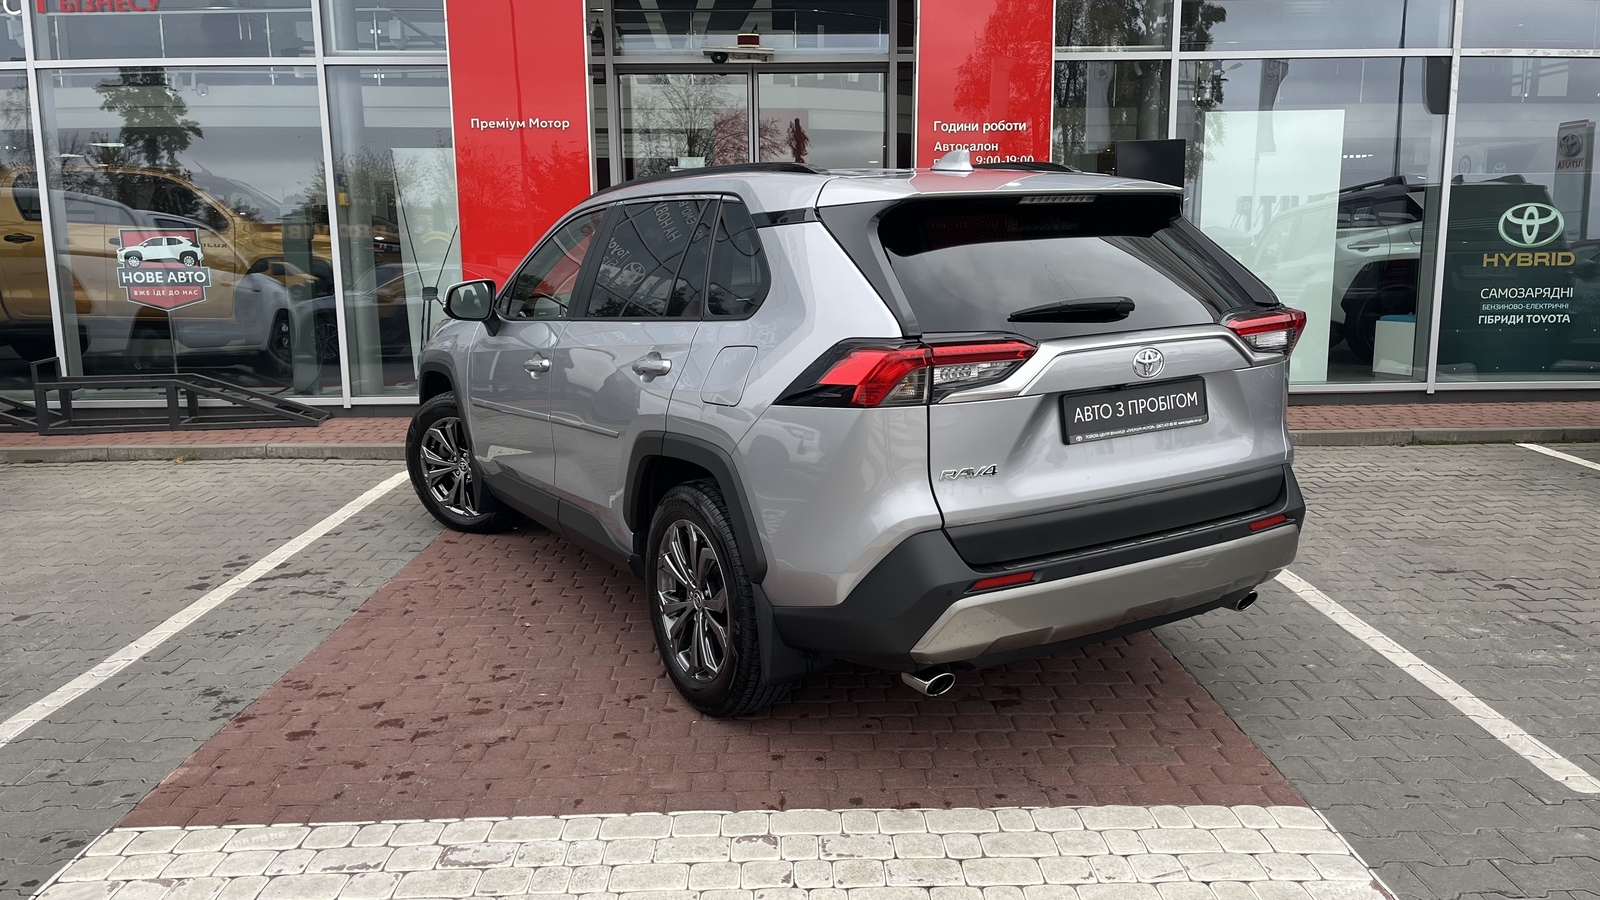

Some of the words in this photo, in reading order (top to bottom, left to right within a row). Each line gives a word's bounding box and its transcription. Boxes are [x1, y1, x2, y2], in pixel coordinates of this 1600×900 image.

[470, 117, 526, 131] Преміум
[528, 117, 570, 131] Мотор
[933, 120, 979, 134] Години
[982, 120, 1027, 134] роботи
[933, 141, 999, 152] Автосалон
[1482, 252, 1576, 268] HYBRID
[122, 271, 164, 284] НОВЕ
[167, 270, 207, 283] АВТО
[153, 289, 166, 297] ЇДЕ
[1480, 287, 1574, 300] САМОЗАРЯДНІ
[1482, 303, 1570, 311] БЕНЗИНОВО-ЕЛЕКТРИЧНІ
[1478, 315, 1524, 325] ГІБРИДИ
[1526, 314, 1571, 324] TOYOTA
[1074, 403, 1113, 423] АВТО
[1116, 401, 1125, 417] З
[1128, 391, 1198, 416] ПРОБІГОМ
[939, 463, 998, 481] RAV4
